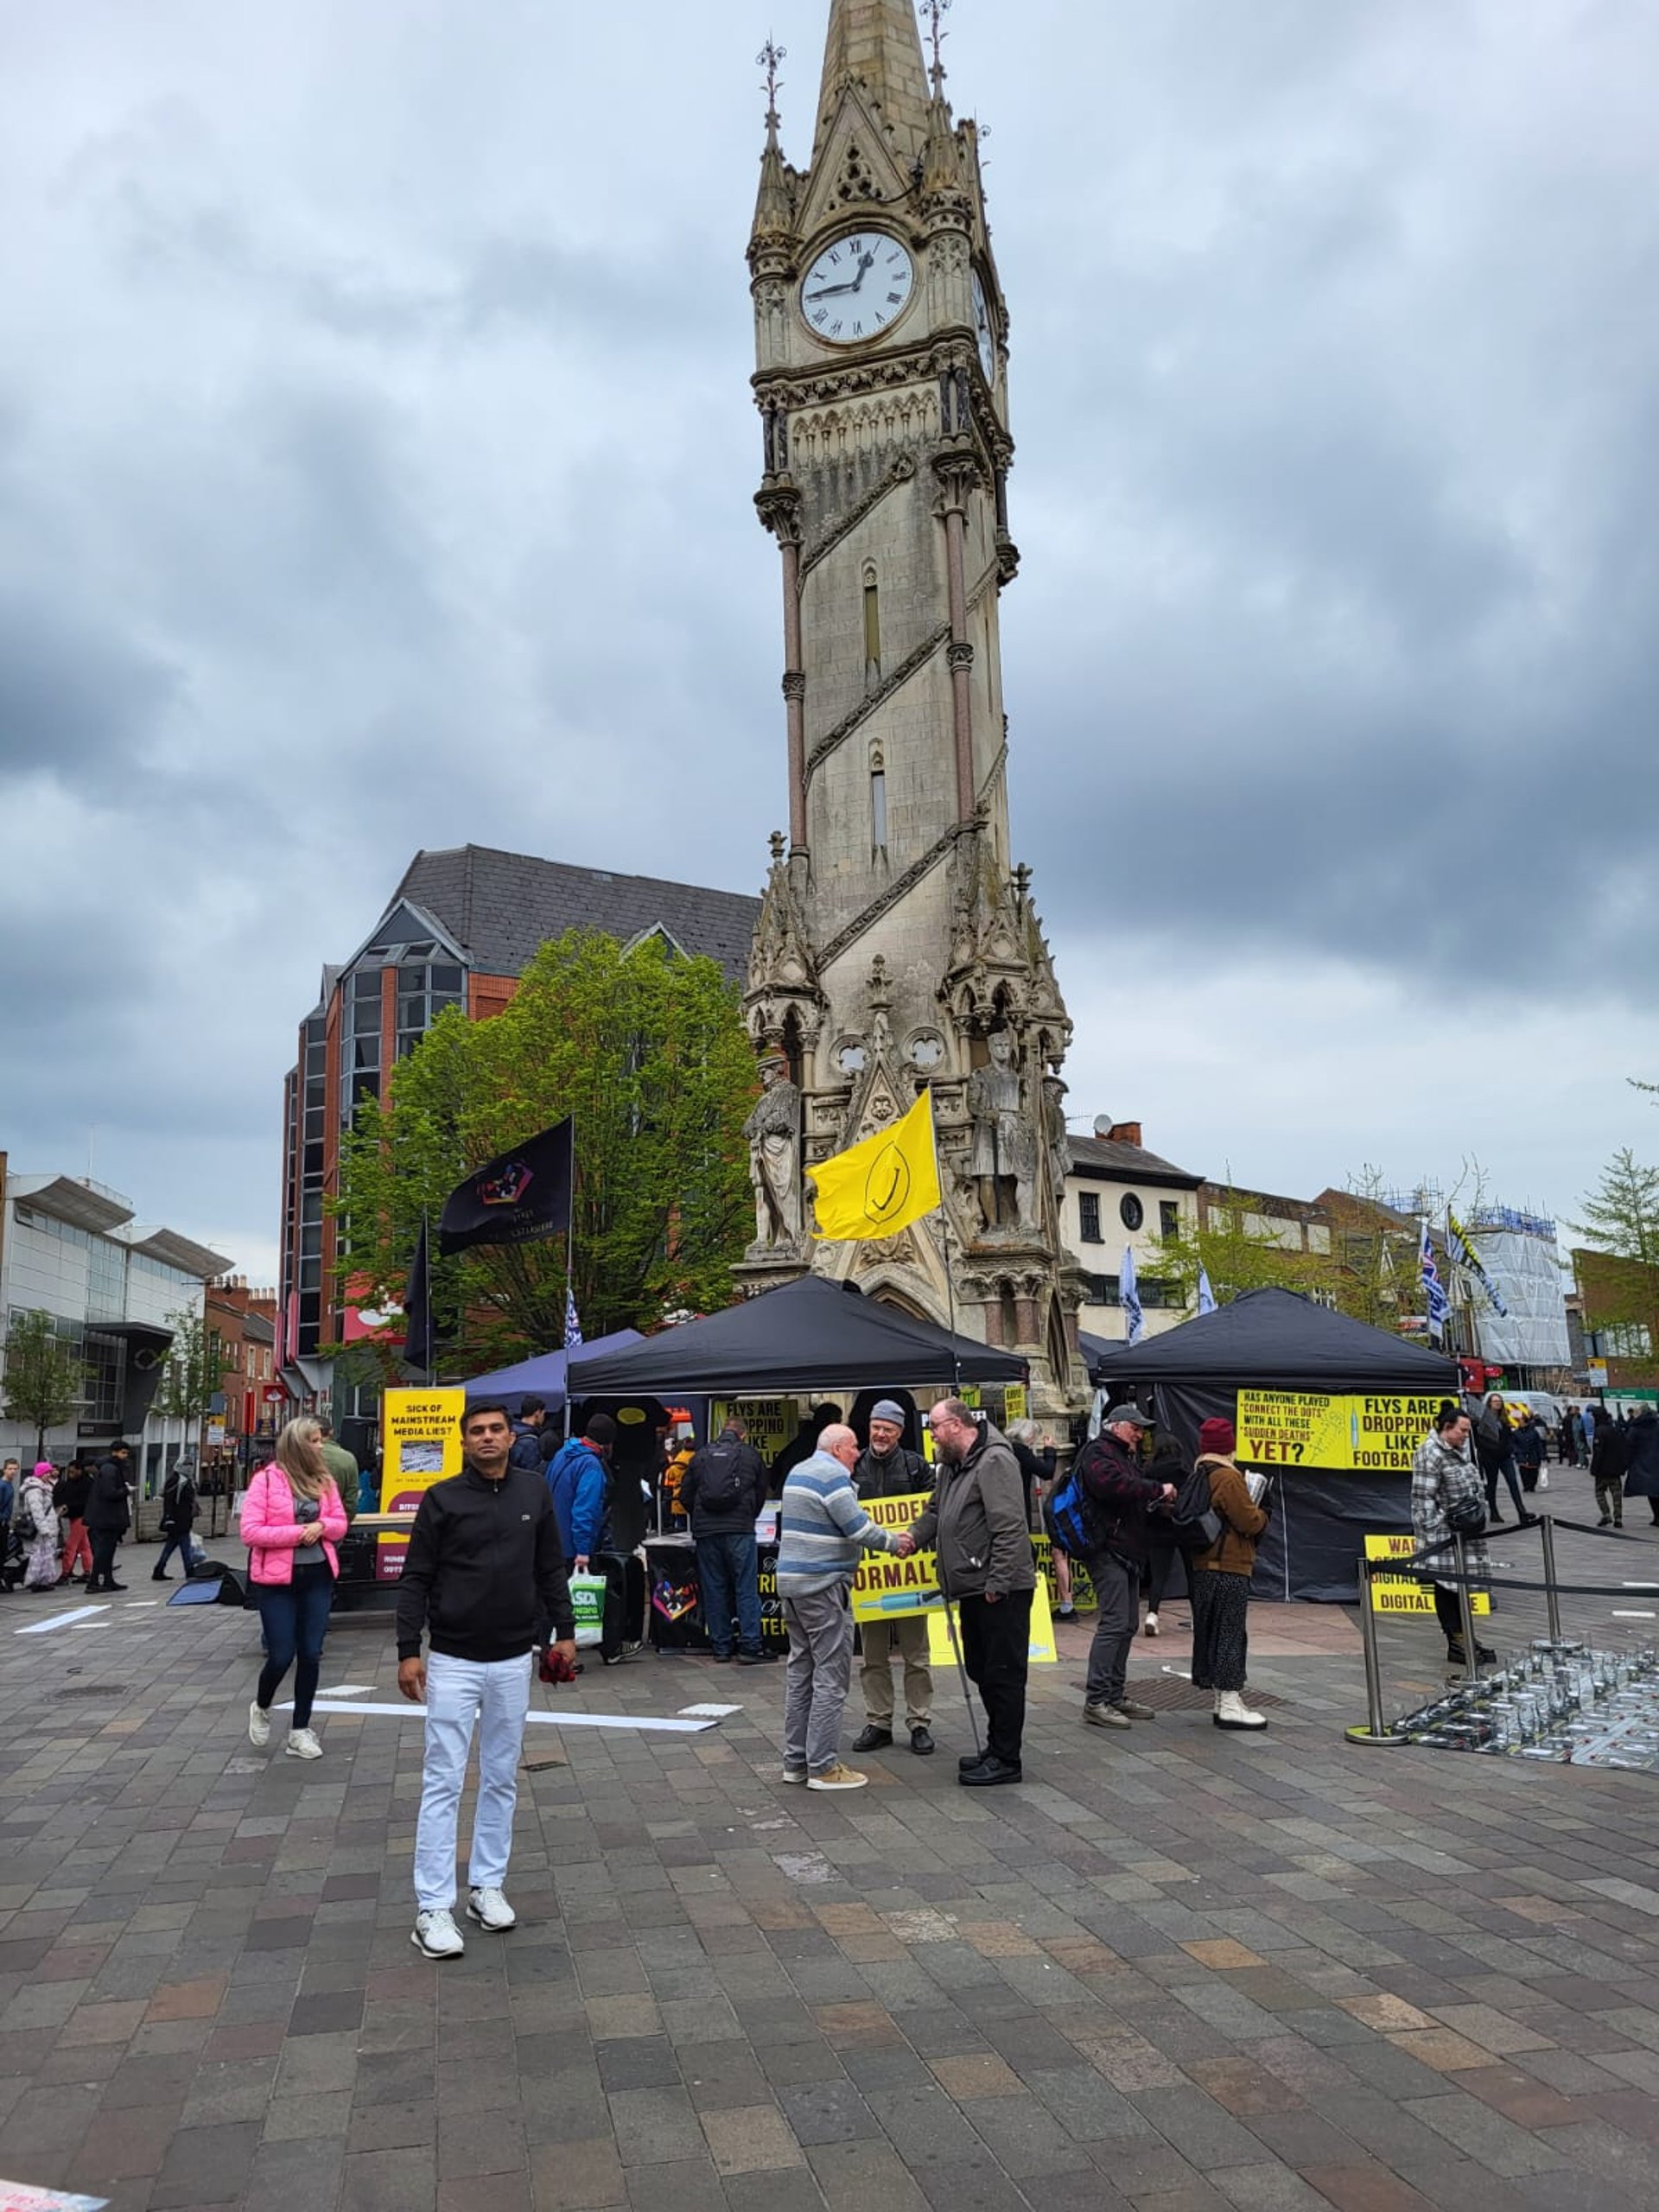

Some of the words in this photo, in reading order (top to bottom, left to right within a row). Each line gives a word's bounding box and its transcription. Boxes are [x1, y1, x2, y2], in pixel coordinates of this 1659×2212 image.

[1244, 1392, 1262, 1402] HAS
[1263, 1393, 1296, 1405] ANYONE
[1298, 1395, 1330, 1408] PLAYED
[1365, 1398, 1402, 1414] FLYS
[1407, 1399, 1439, 1415] ARE
[406, 1404, 428, 1413] SICK
[429, 1404, 442, 1413] OF
[727, 1402, 754, 1417] FLYS
[758, 1403, 782, 1417] ARE
[1283, 1406, 1300, 1416] THE
[391, 1415, 455, 1425] MAINSTREAM
[1244, 1414, 1264, 1425] WITH
[1267, 1417, 1282, 1427] ALL
[1285, 1418, 1311, 1429] THESE
[394, 1427, 424, 1436] MEDIA
[747, 1435, 768, 1449] IKE
[1385, 1434, 1421, 1451] LIKE
[1249, 1440, 1304, 1463] YET?
[1353, 1451, 1415, 1468] FOOTBA
[1381, 1594, 1433, 1611] DIGITAL
